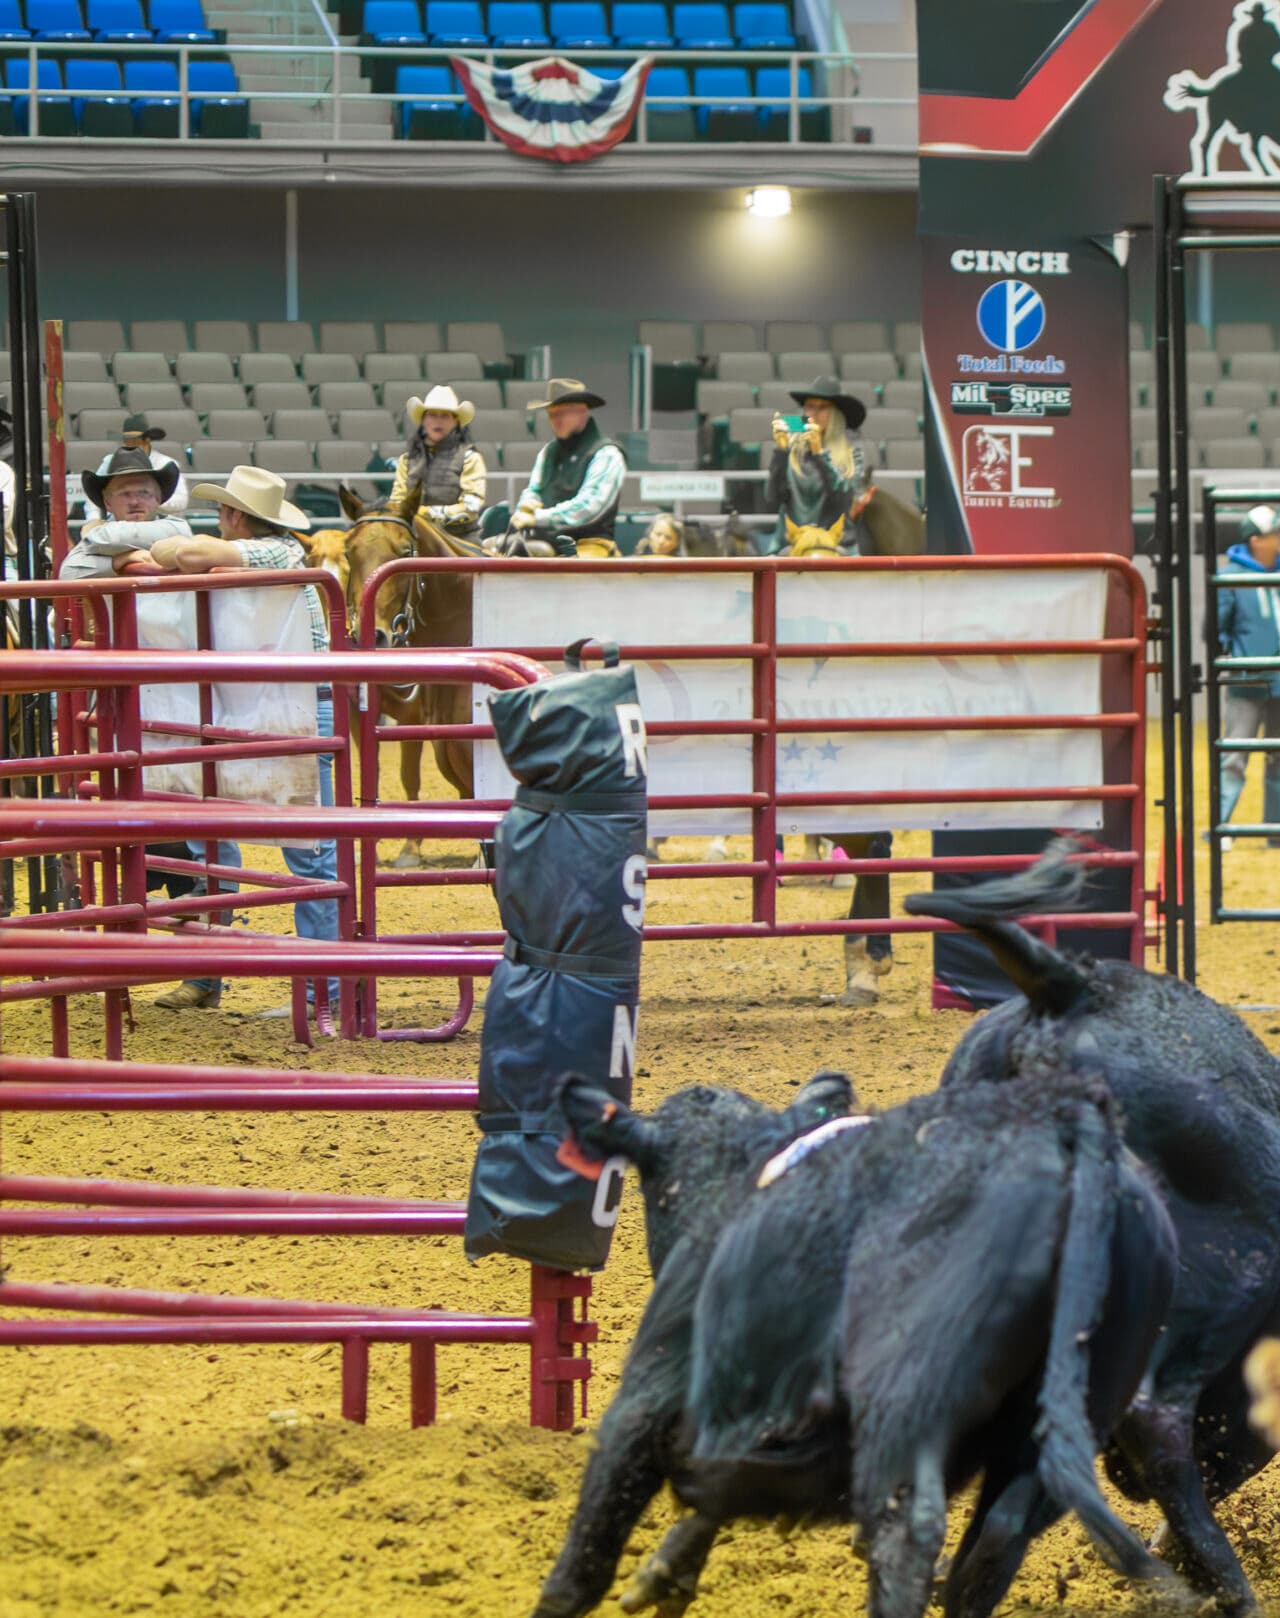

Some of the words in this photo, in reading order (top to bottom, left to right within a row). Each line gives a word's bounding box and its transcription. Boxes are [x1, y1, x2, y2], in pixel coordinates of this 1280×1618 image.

[950, 249, 1071, 274] CINCH
[957, 354, 1007, 374] Total
[1009, 355, 1066, 375] Feeds
[951, 384, 989, 403] Mil
[1009, 386, 1072, 407] Spec
